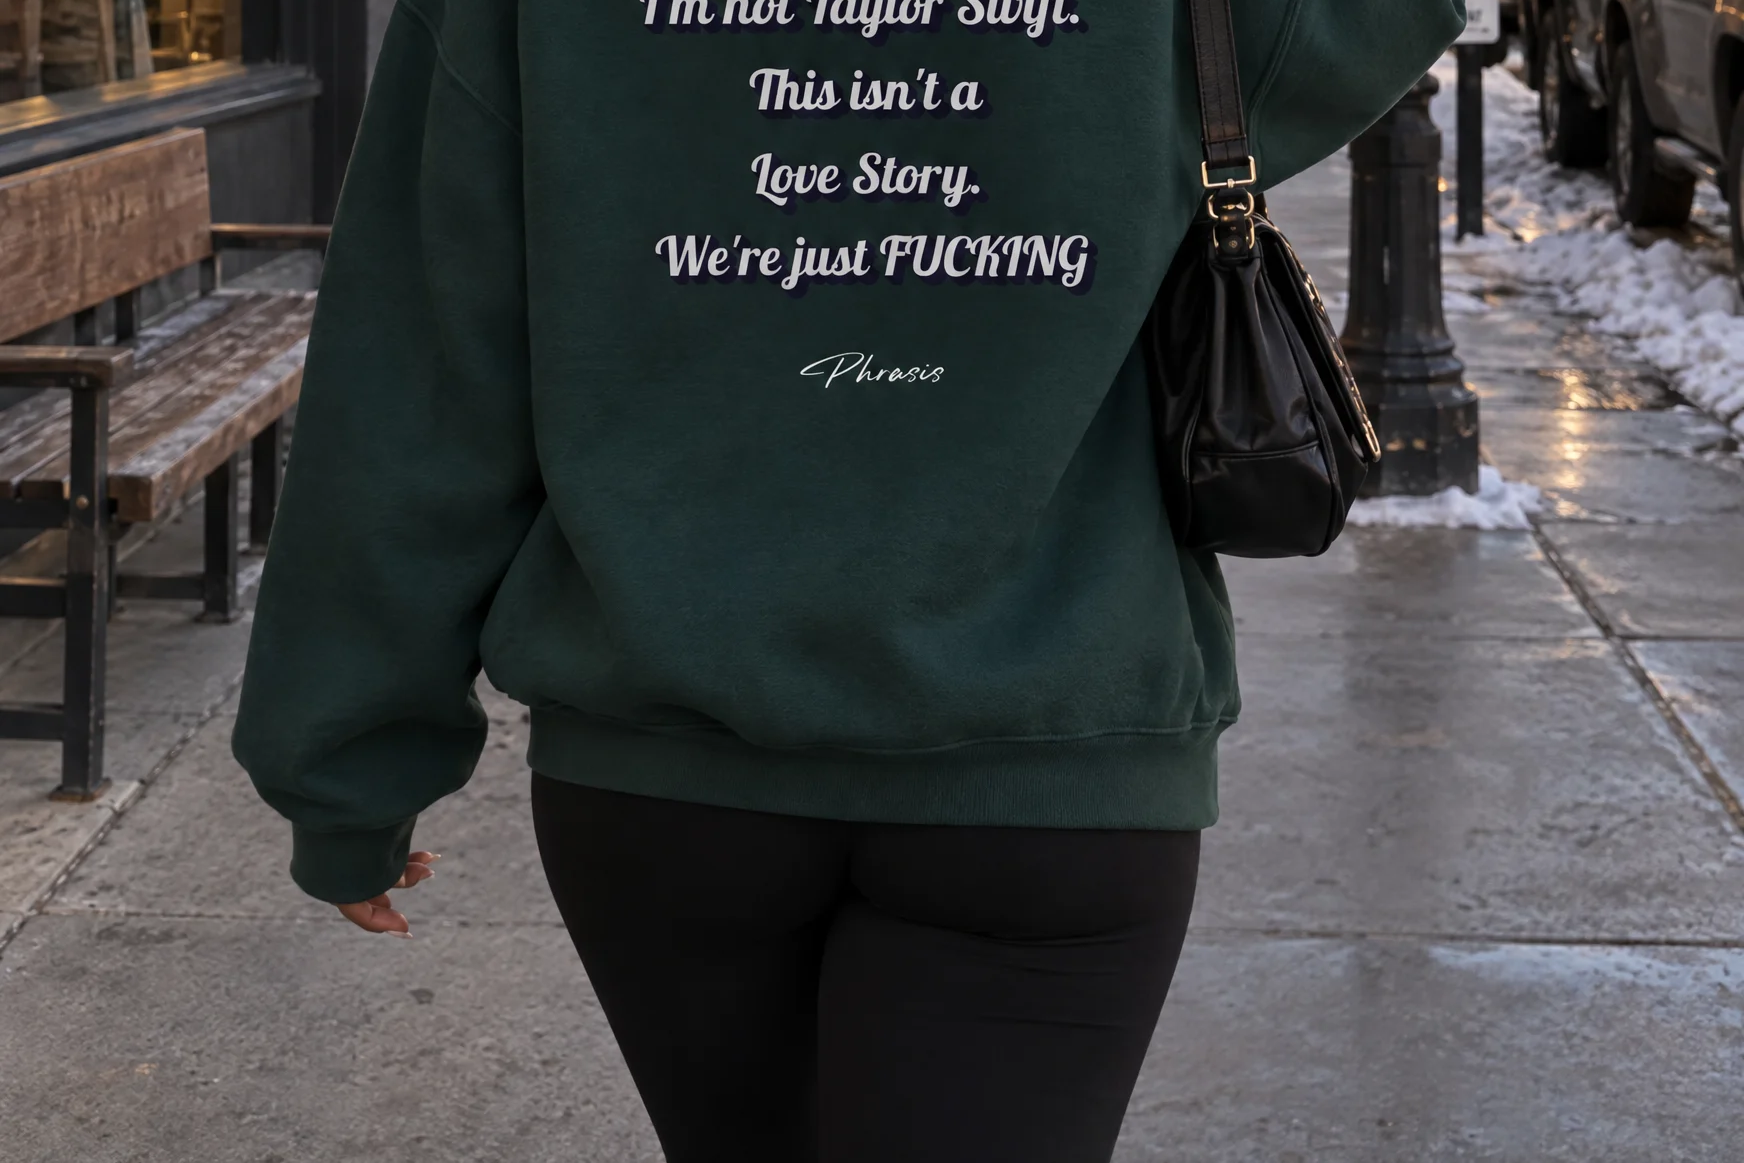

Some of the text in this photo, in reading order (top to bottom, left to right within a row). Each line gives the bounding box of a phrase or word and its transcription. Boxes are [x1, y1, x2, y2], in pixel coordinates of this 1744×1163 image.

[749, 68, 984, 111] This isn't a
[750, 152, 981, 208] Love Story.
[655, 234, 1089, 290] We're just FUCKING
[800, 351, 945, 389] Phrasis
